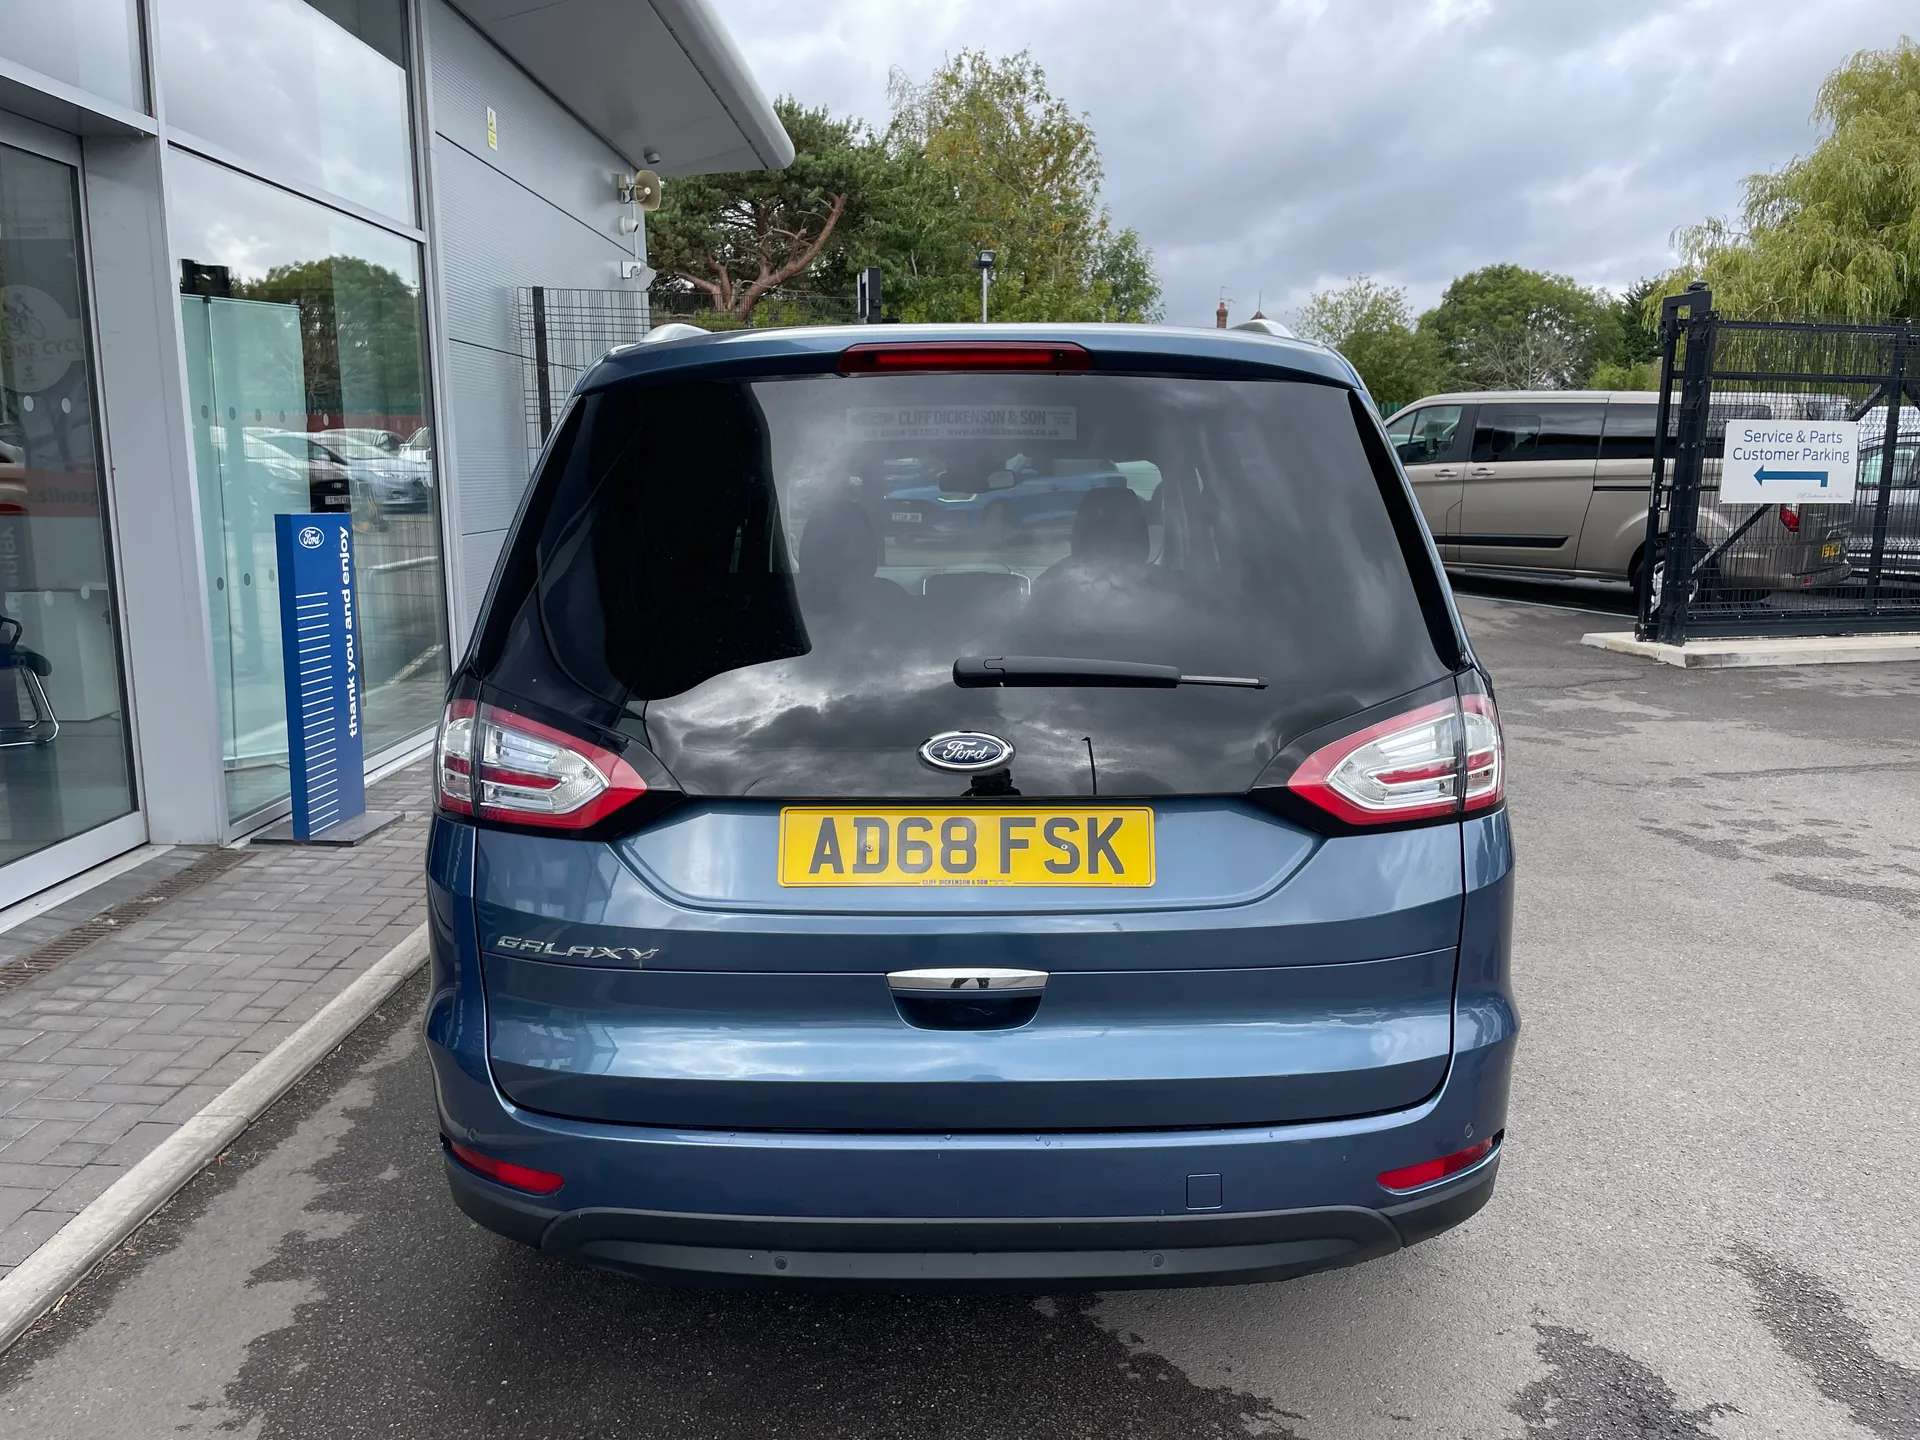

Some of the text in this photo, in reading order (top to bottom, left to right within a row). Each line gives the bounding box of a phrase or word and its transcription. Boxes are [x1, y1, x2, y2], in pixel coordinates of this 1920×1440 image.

[898, 409, 934, 426] CLIFF
[935, 409, 1005, 426] DICKENSON
[1007, 409, 1017, 426] &
[1020, 409, 1047, 426] SON
[1743, 429, 1843, 444] Service & Parts
[1733, 447, 1850, 464] Customer Parking
[339, 526, 358, 738] thank you and enjoy
[942, 740, 988, 761] Ford
[808, 816, 1125, 875] AD68 FSK
[497, 935, 660, 963] GALAXY
